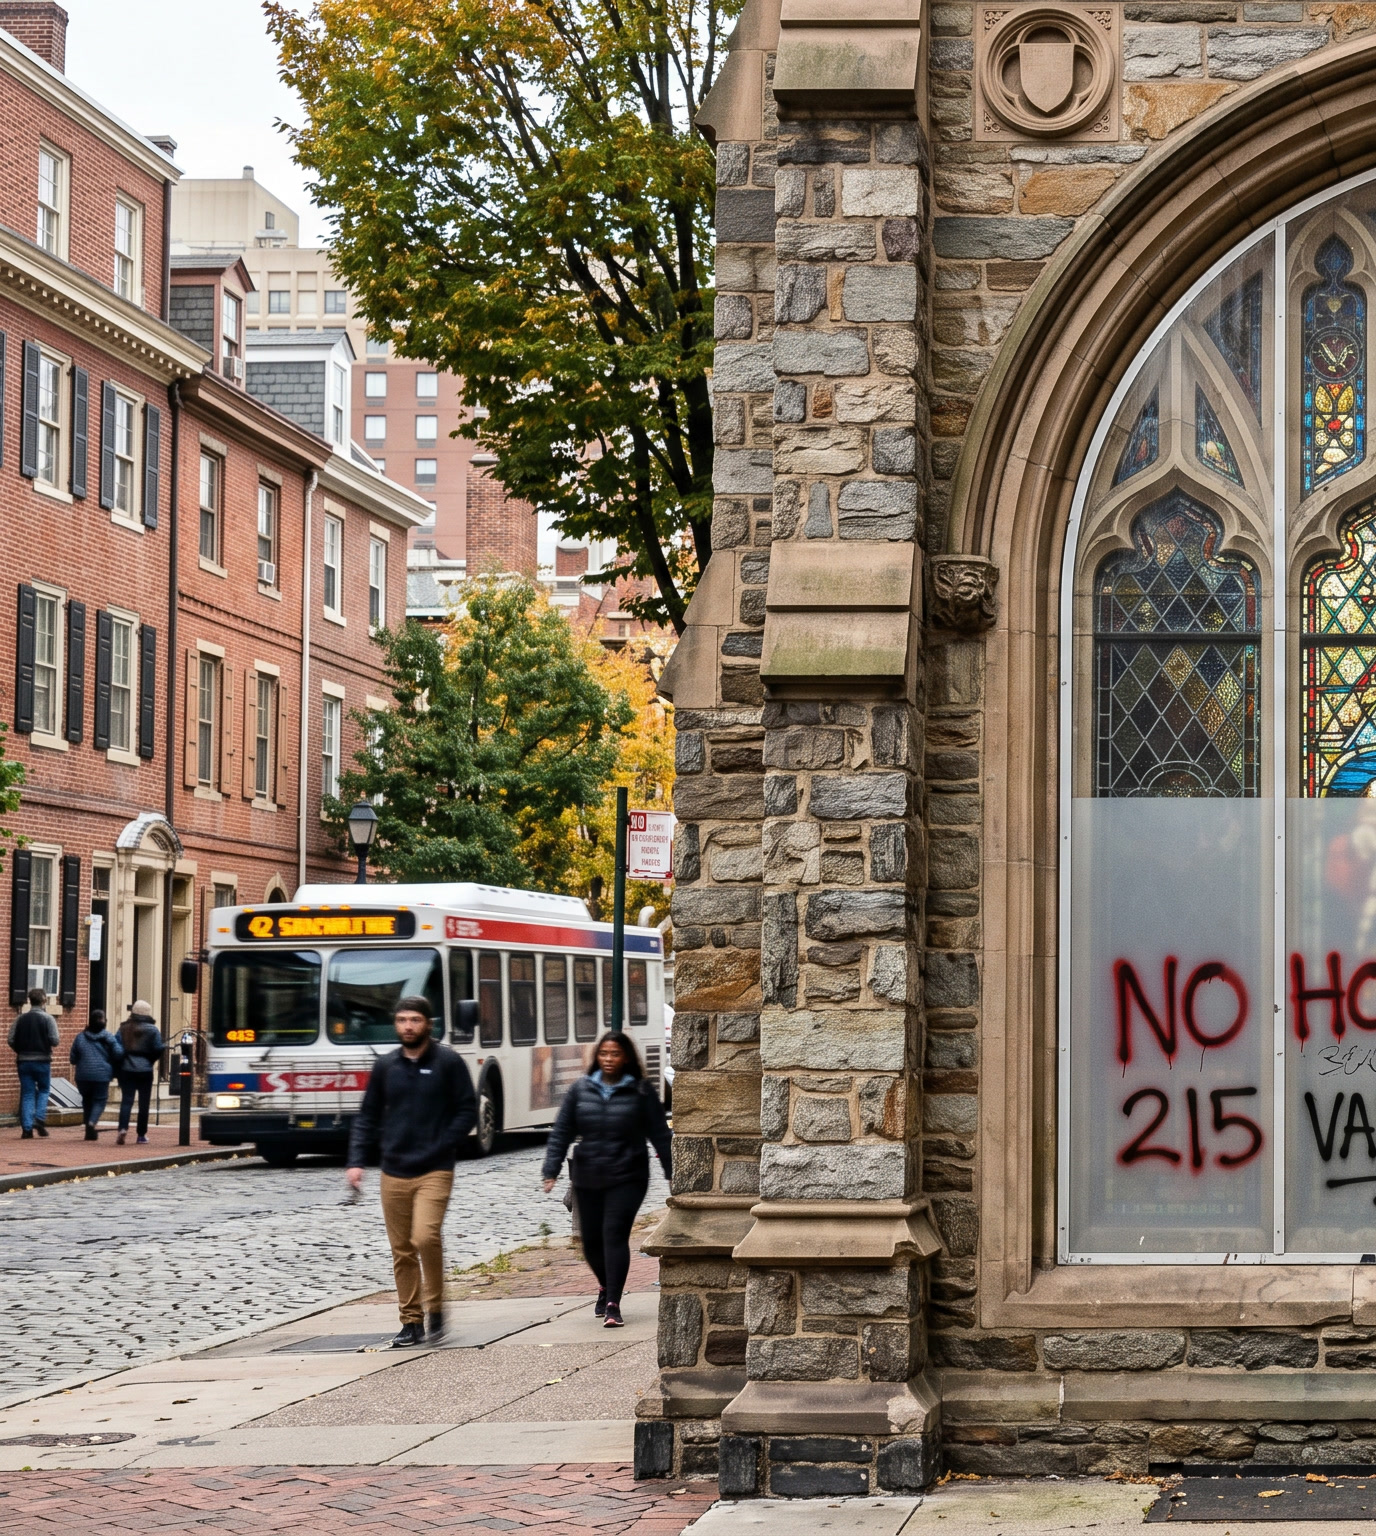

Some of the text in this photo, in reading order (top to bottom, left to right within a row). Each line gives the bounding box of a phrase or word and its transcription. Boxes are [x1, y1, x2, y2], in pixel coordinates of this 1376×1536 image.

[1114, 952, 1250, 1067] NO
[293, 1073, 358, 1090] SEPTA
[1118, 1085, 1266, 1176] 215
